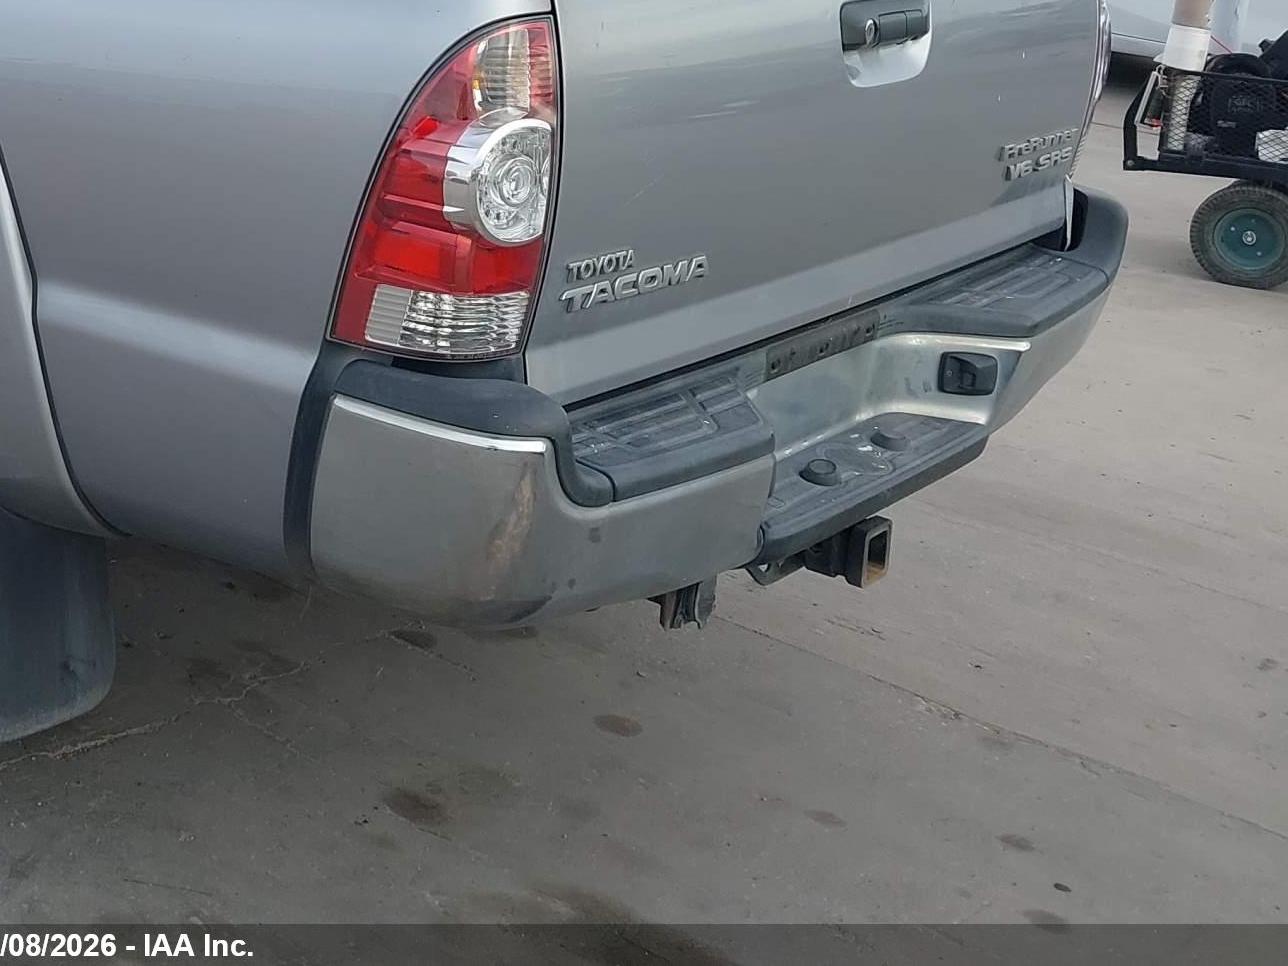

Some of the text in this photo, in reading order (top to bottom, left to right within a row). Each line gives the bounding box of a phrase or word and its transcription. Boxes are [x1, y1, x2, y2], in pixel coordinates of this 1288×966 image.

[1004, 146, 1073, 181] V6 SR5
[567, 250, 634, 282] TOYOTA
[560, 255, 709, 313] TACOMA
